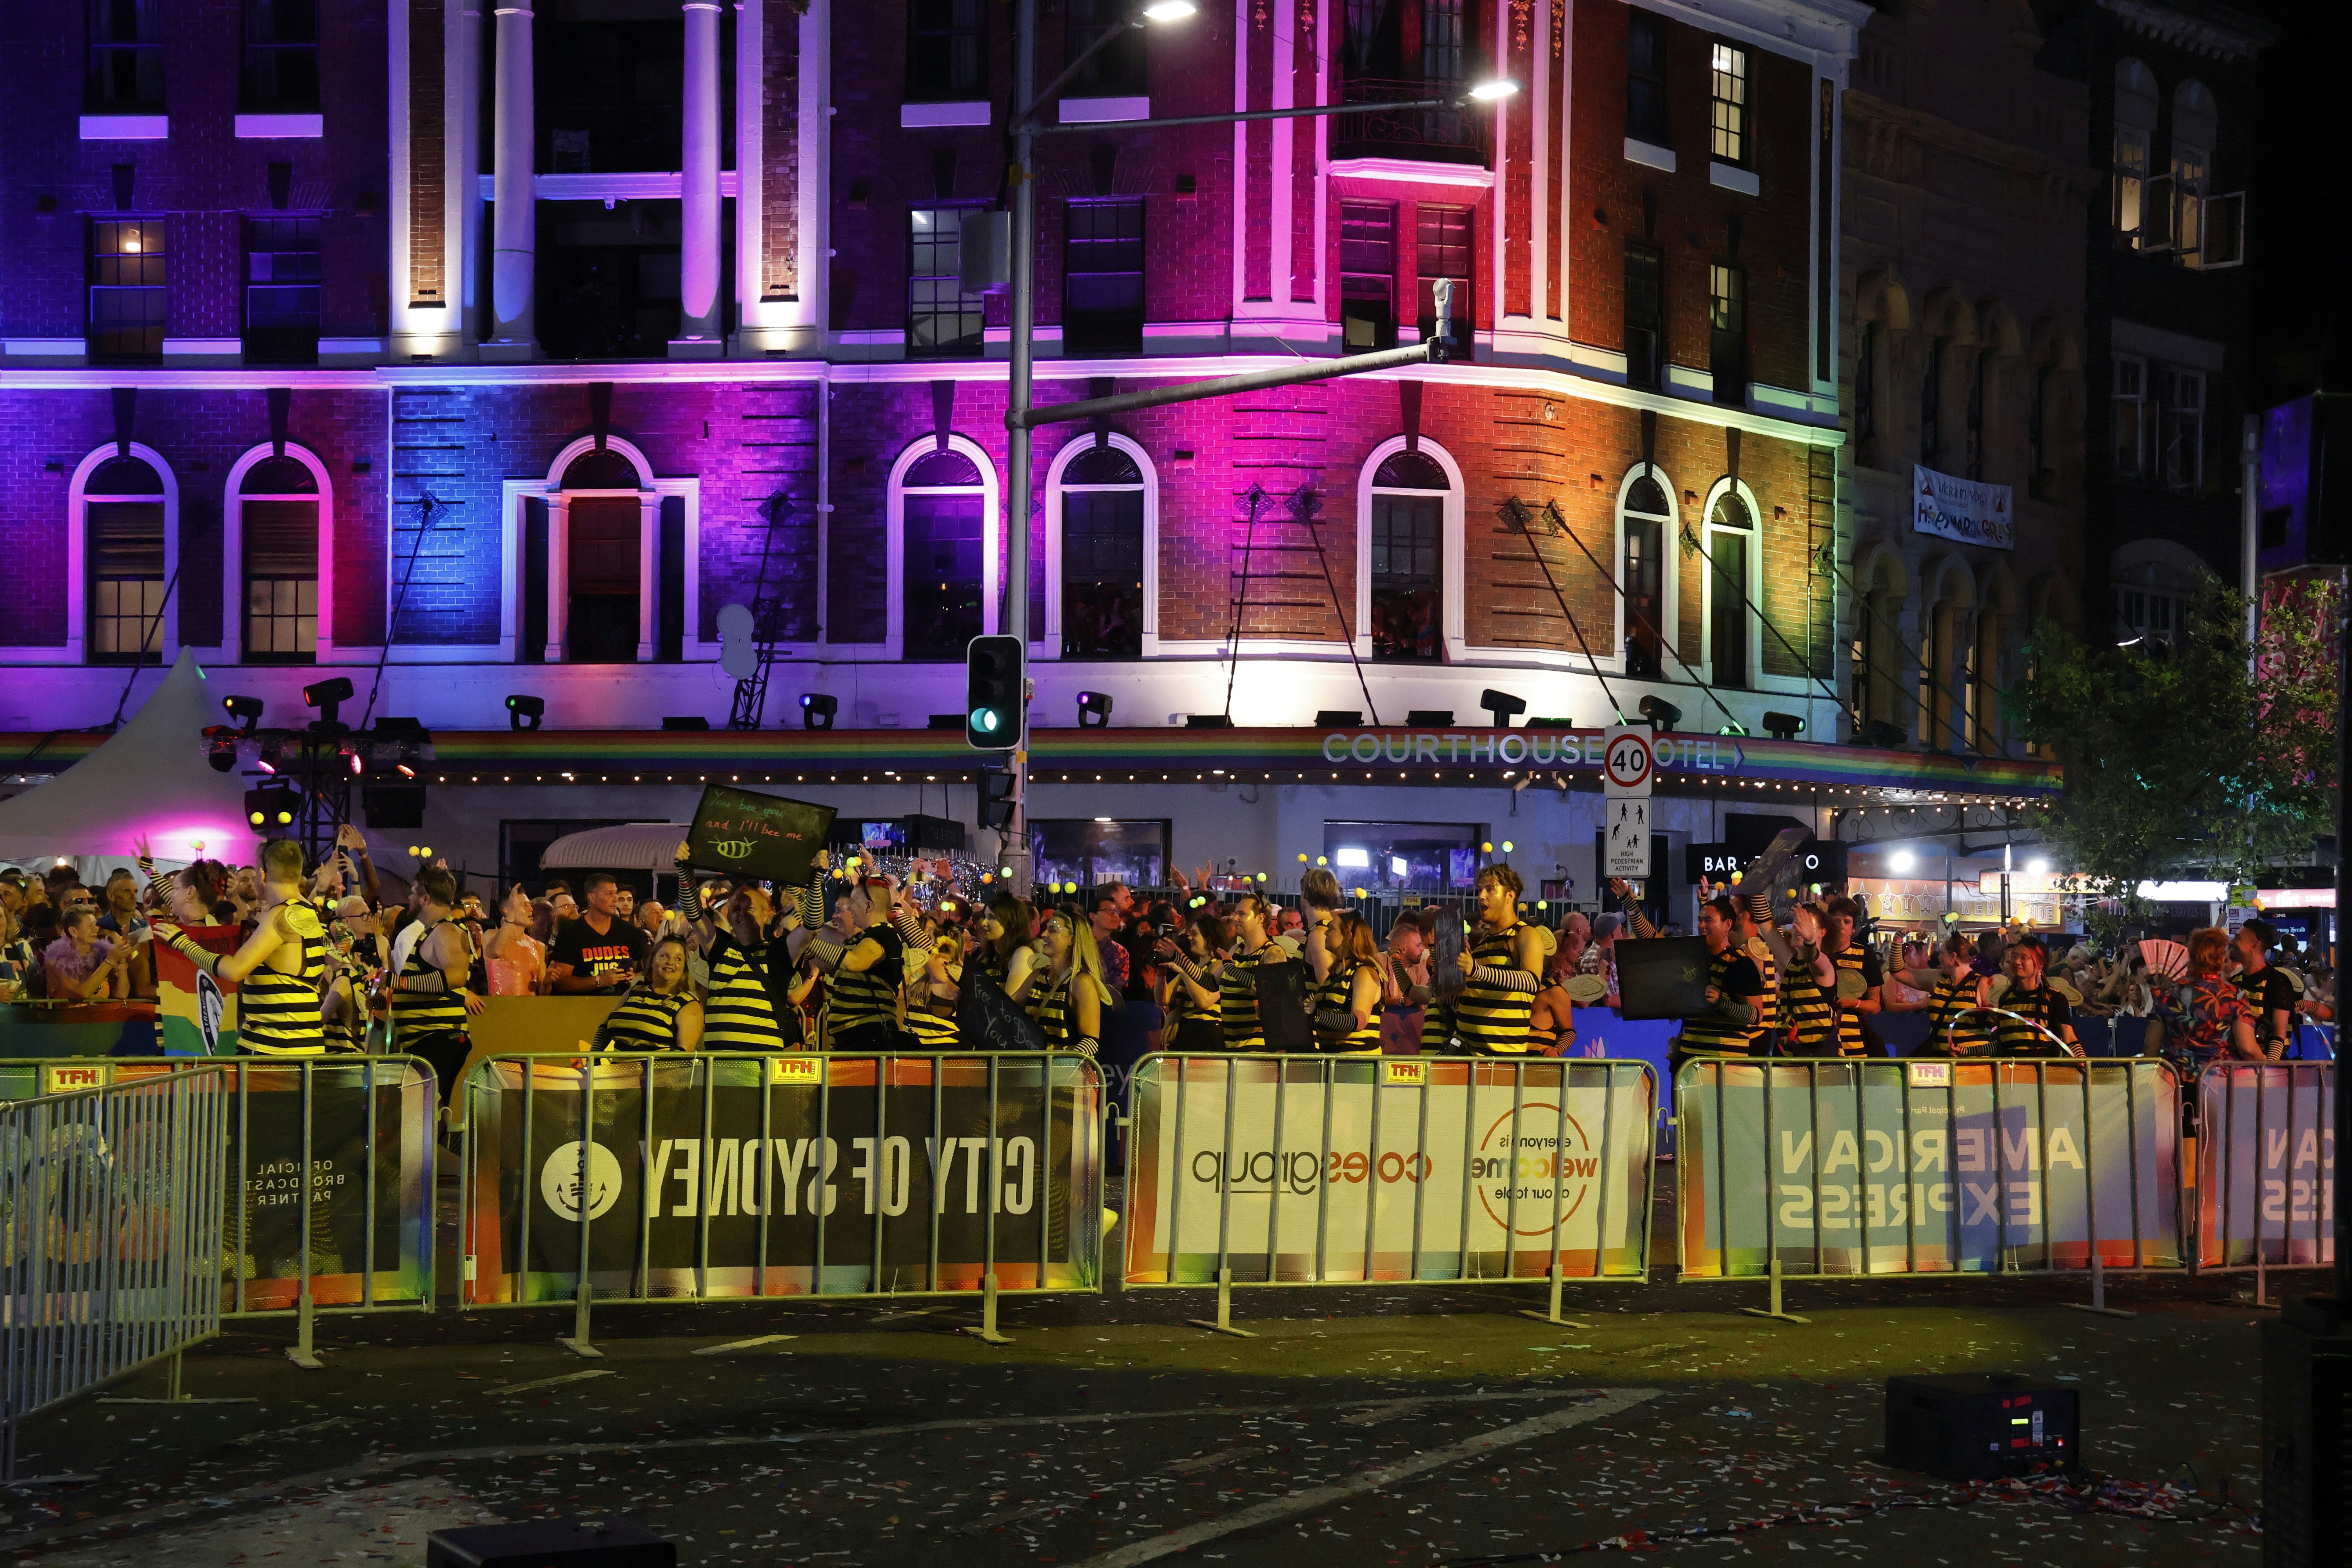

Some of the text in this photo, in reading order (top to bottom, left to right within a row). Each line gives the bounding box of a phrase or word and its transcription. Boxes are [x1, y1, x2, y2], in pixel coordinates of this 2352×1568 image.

[1322, 733, 1725, 771] COURTHOUSE OTEL
[1612, 749, 1644, 772] 40
[739, 798, 757, 812] bee
[760, 808, 783, 820] you
[706, 820, 730, 830] and
[739, 819, 759, 831] I'll
[761, 823, 781, 837] bee
[1704, 856, 1737, 871] BAR
[1962, 891, 2018, 916] KEBB
[2026, 905, 2053, 922] PIDE
[582, 946, 630, 962] DUDES
[1000, 1000, 1011, 1023] to
[985, 1006, 1007, 1049] You
[779, 1060, 812, 1073] TFH
[1391, 1064, 1418, 1076] TFH
[1915, 1065, 1942, 1077] TFH
[56, 1070, 96, 1084] TFH
